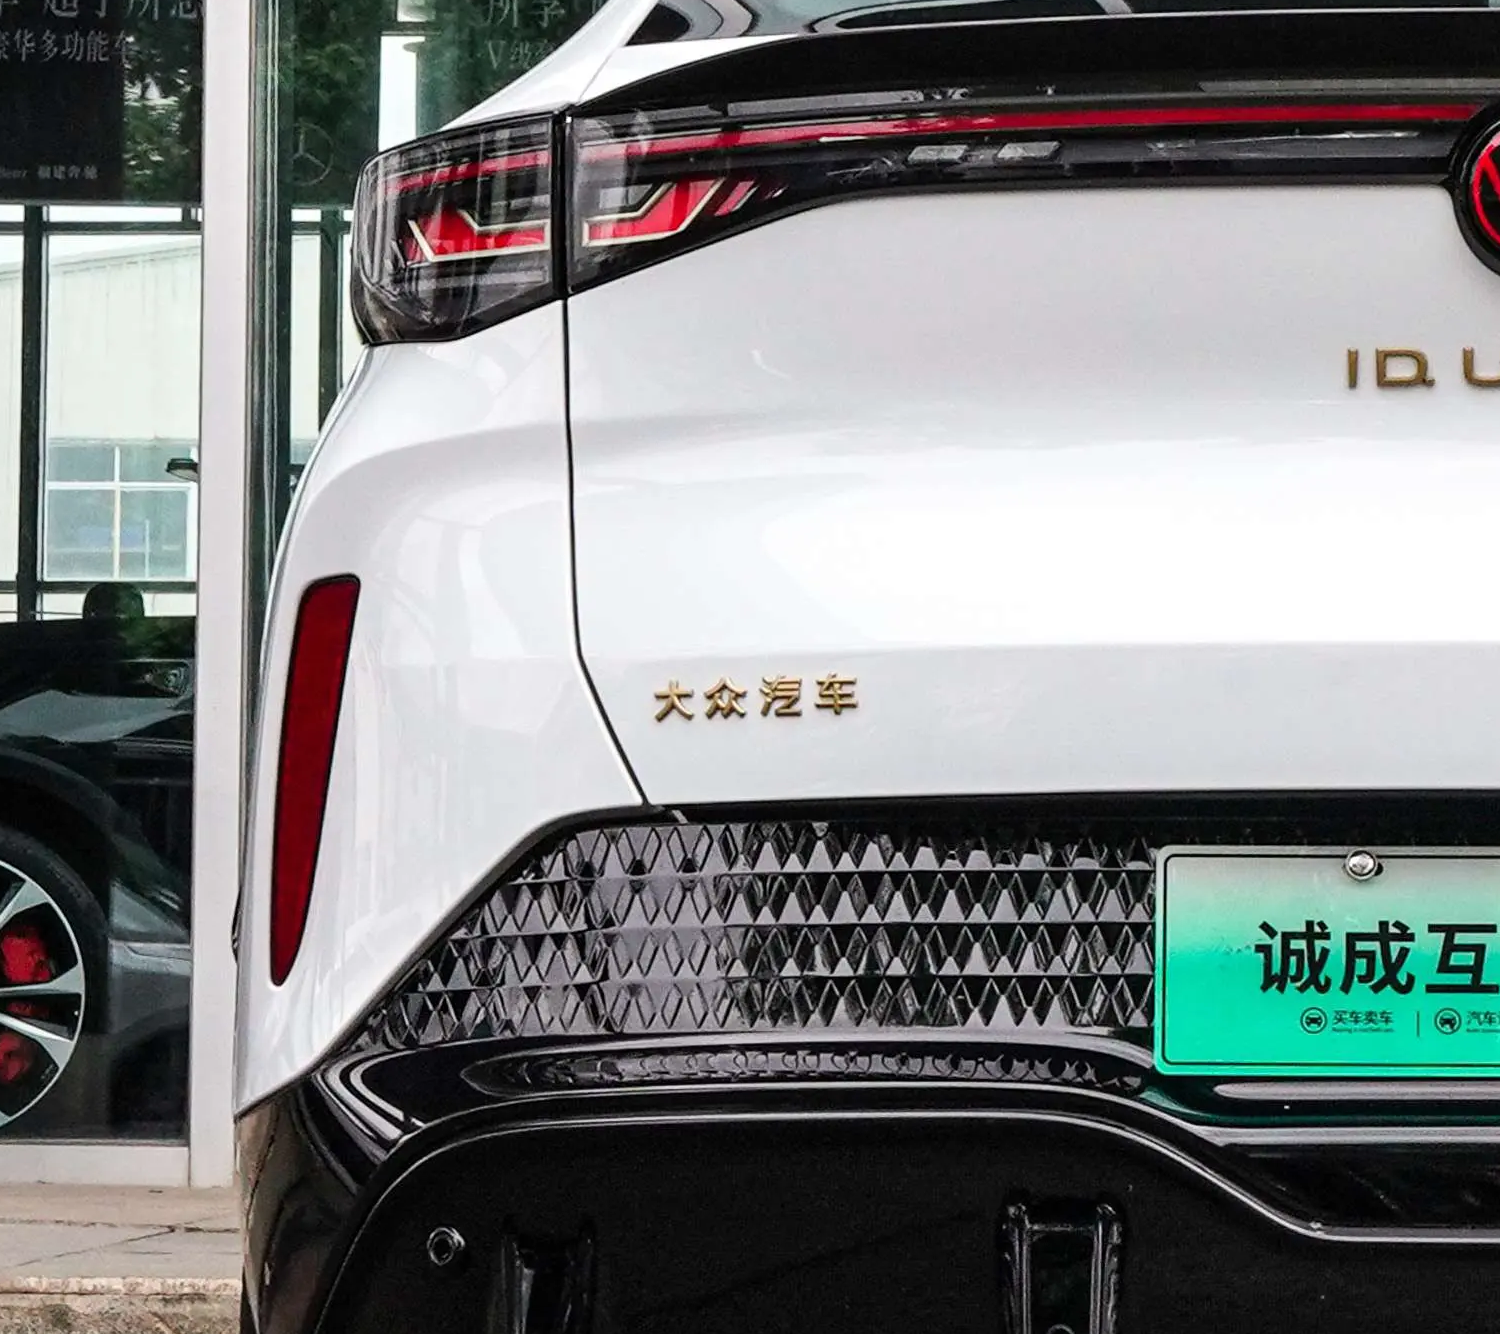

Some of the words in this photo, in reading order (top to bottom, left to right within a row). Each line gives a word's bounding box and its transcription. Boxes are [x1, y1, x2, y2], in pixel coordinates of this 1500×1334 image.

[654, 672, 859, 723] 大众汽车
[1332, 1009, 1394, 1026] 买车卖车
